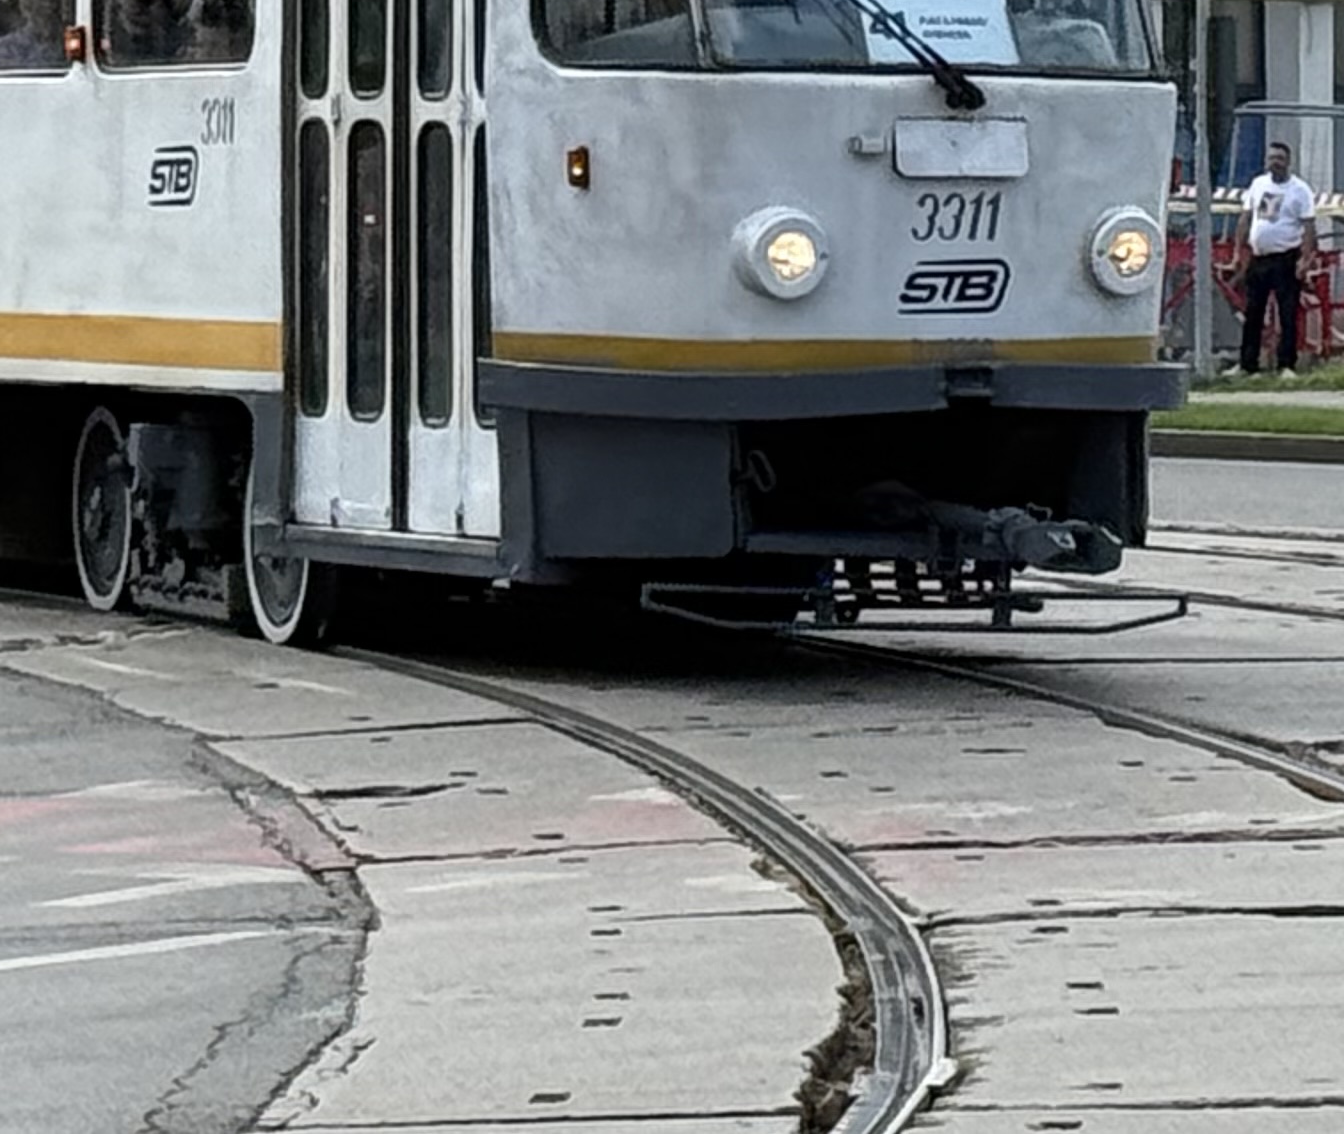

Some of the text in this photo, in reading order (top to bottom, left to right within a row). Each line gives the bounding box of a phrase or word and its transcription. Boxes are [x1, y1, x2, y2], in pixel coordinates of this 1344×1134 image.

[149, 157, 193, 195] STB
[911, 191, 1001, 241] 3311
[899, 270, 999, 304] STB
